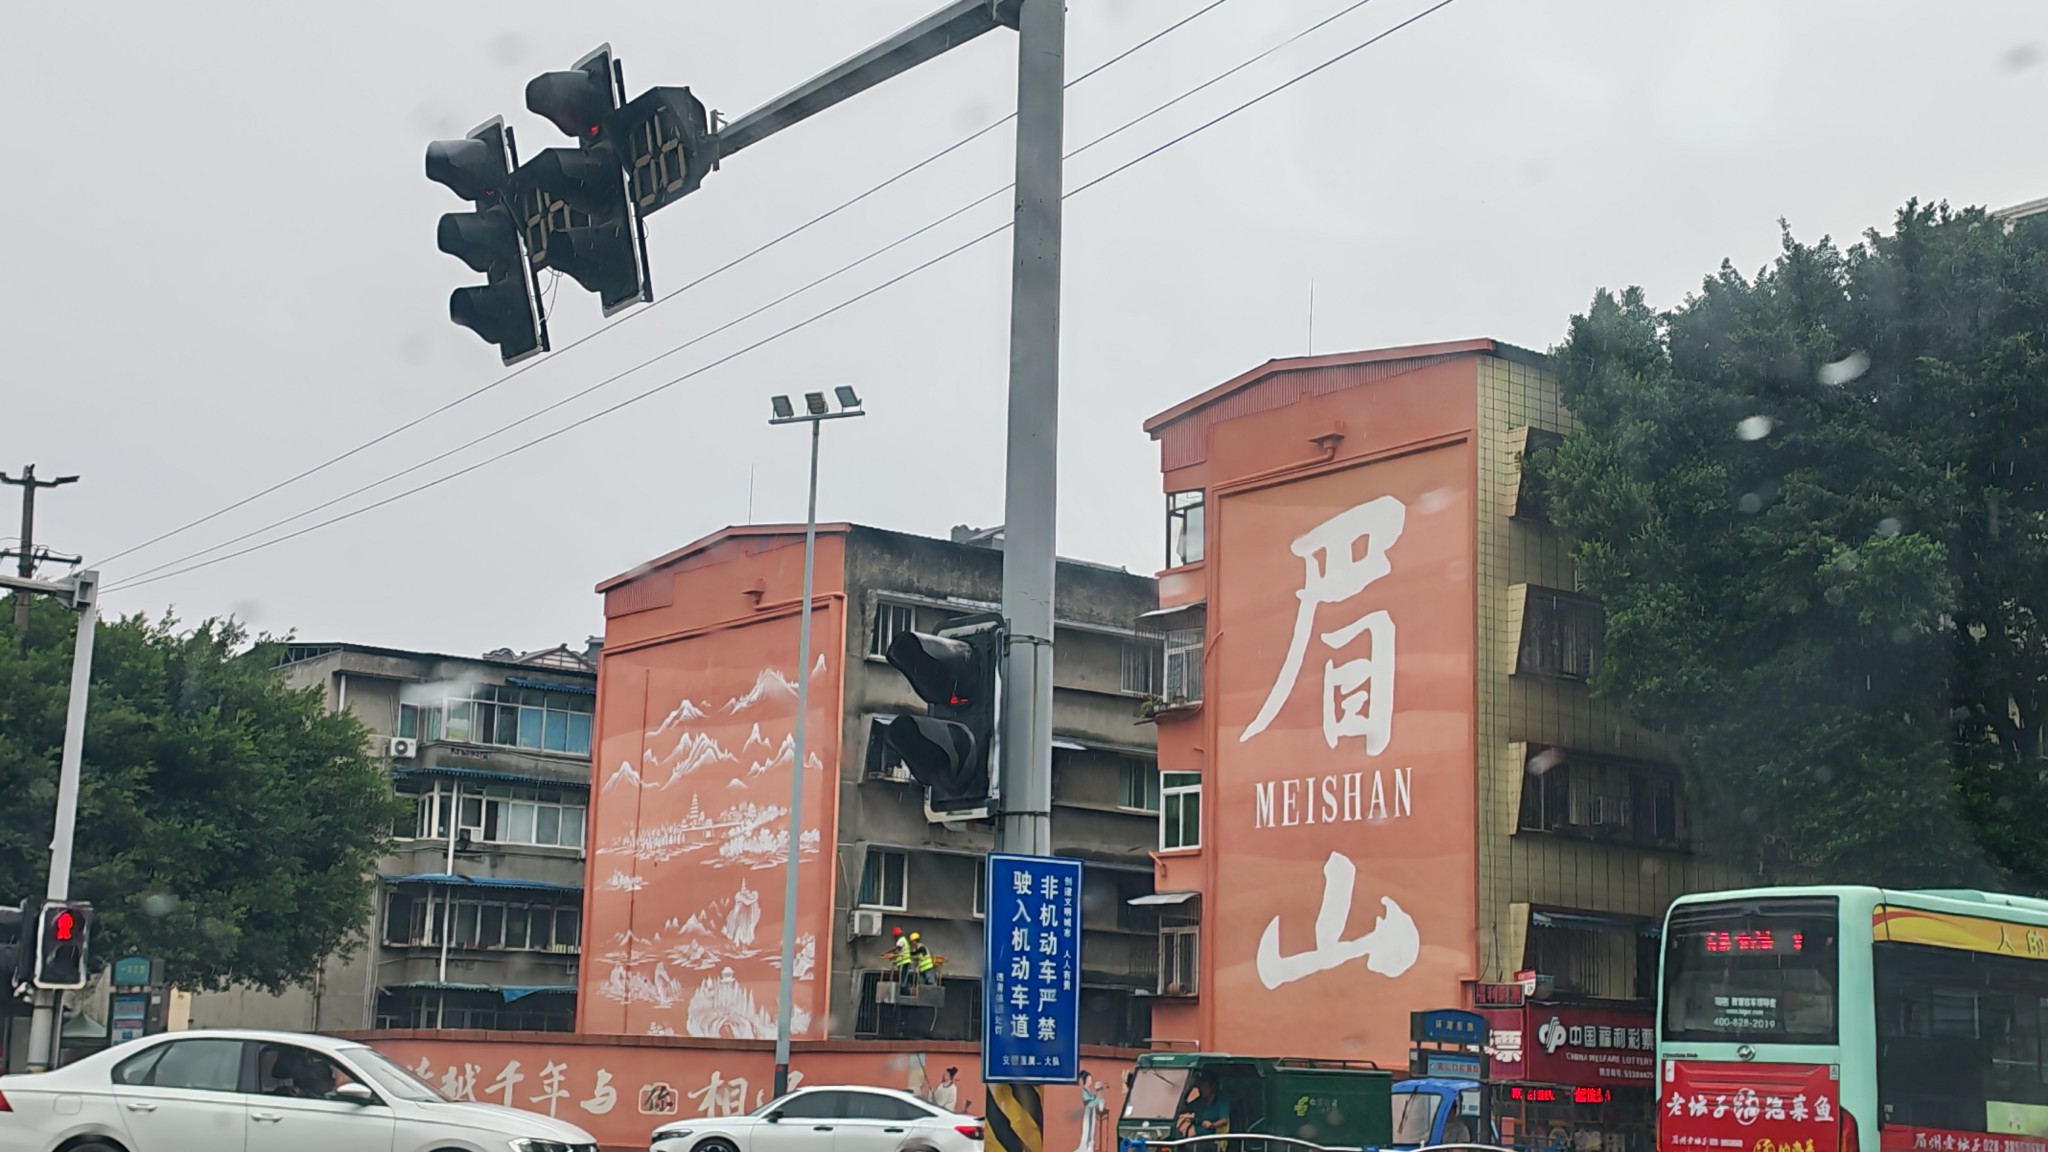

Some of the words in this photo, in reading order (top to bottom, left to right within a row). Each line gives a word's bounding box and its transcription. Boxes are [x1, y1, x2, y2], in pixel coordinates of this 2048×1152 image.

[1240, 495, 1405, 756] 眉
[1255, 767, 1412, 829] MEISHAN
[1010, 870, 1032, 1039] 驶入机动车道
[1037, 875, 1059, 1041] 非机动车严禁
[1257, 851, 1419, 990] 山
[407, 1056, 804, 1118] 越千年与你相
[1569, 1025, 1654, 1051] 中国福利彩票
